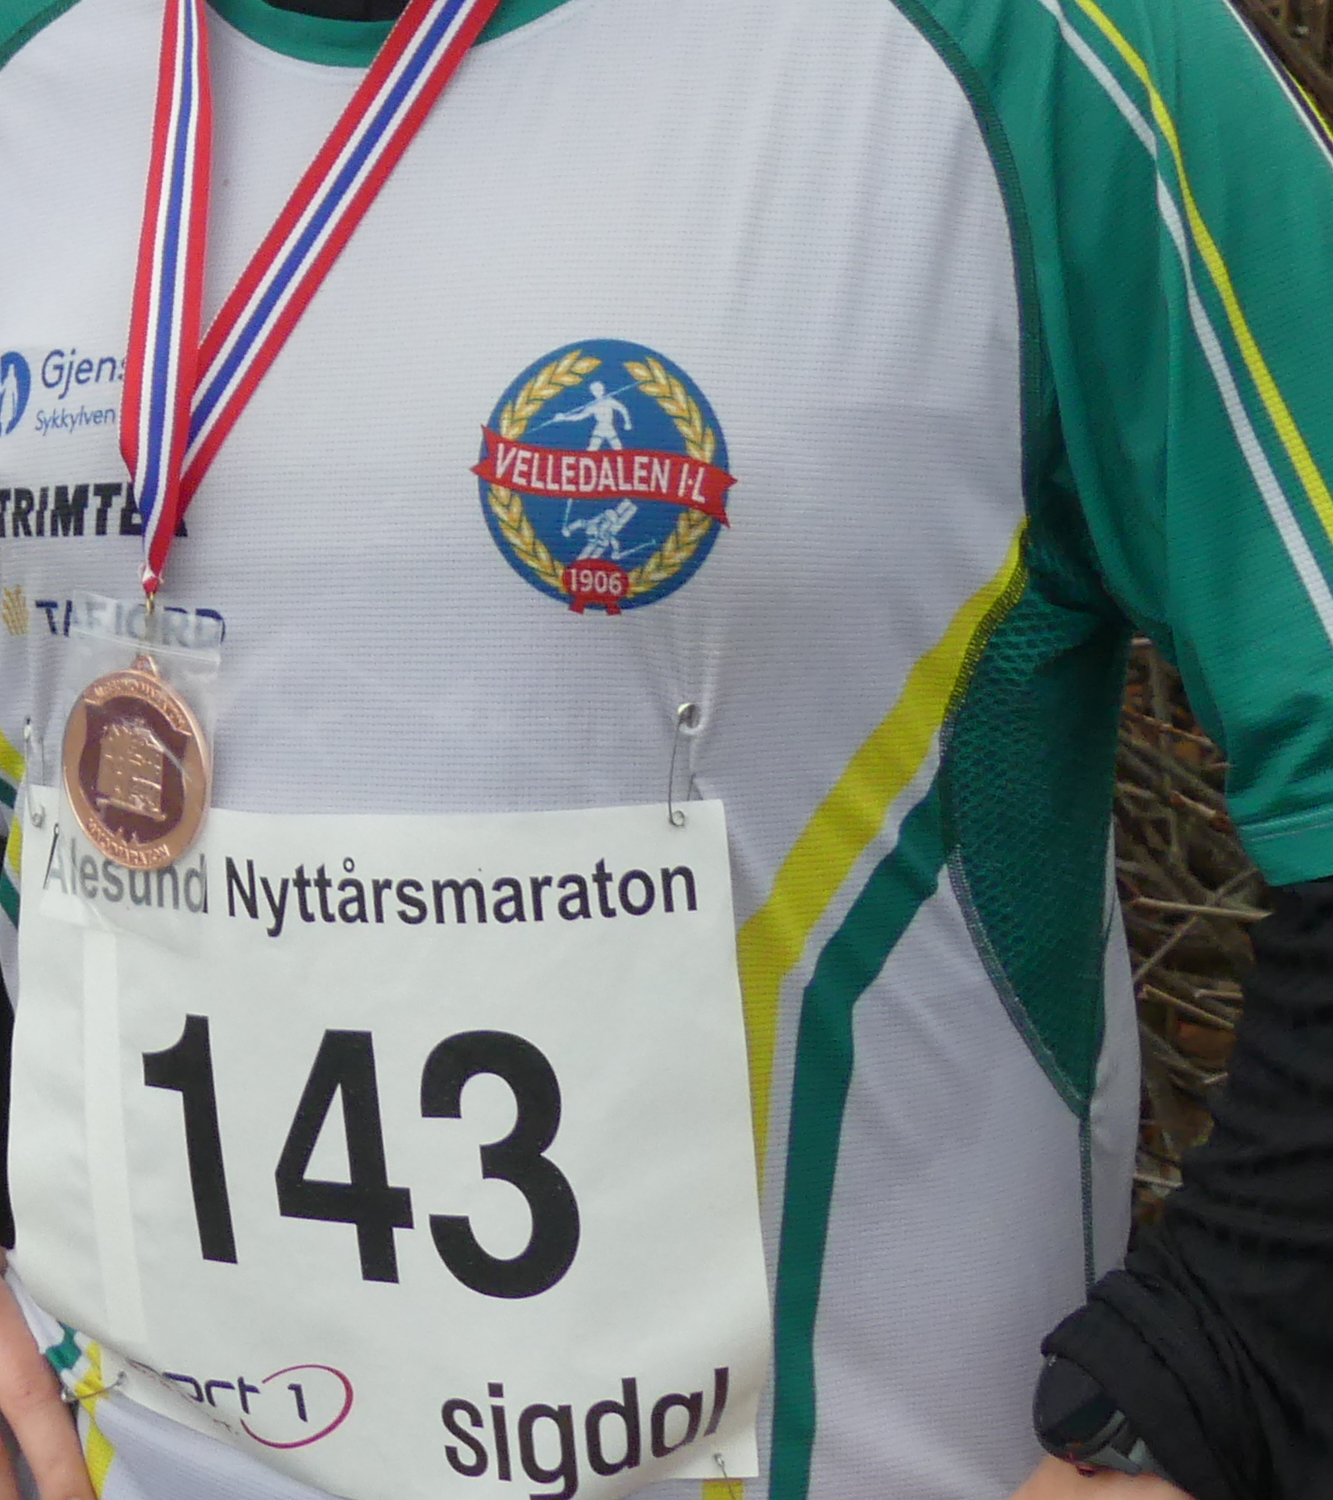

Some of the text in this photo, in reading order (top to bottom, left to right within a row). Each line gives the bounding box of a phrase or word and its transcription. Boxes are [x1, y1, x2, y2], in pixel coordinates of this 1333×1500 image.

[41, 348, 126, 400] Gjen
[35, 405, 116, 436] Sykkylven
[494, 443, 671, 494] VELLEDALEN
[569, 568, 622, 595] 1906
[225, 856, 698, 937] Nyttårsmaraton
[141, 1013, 581, 1300] 143
[288, 1383, 308, 1422] 1
[441, 1367, 729, 1500] sigdal
